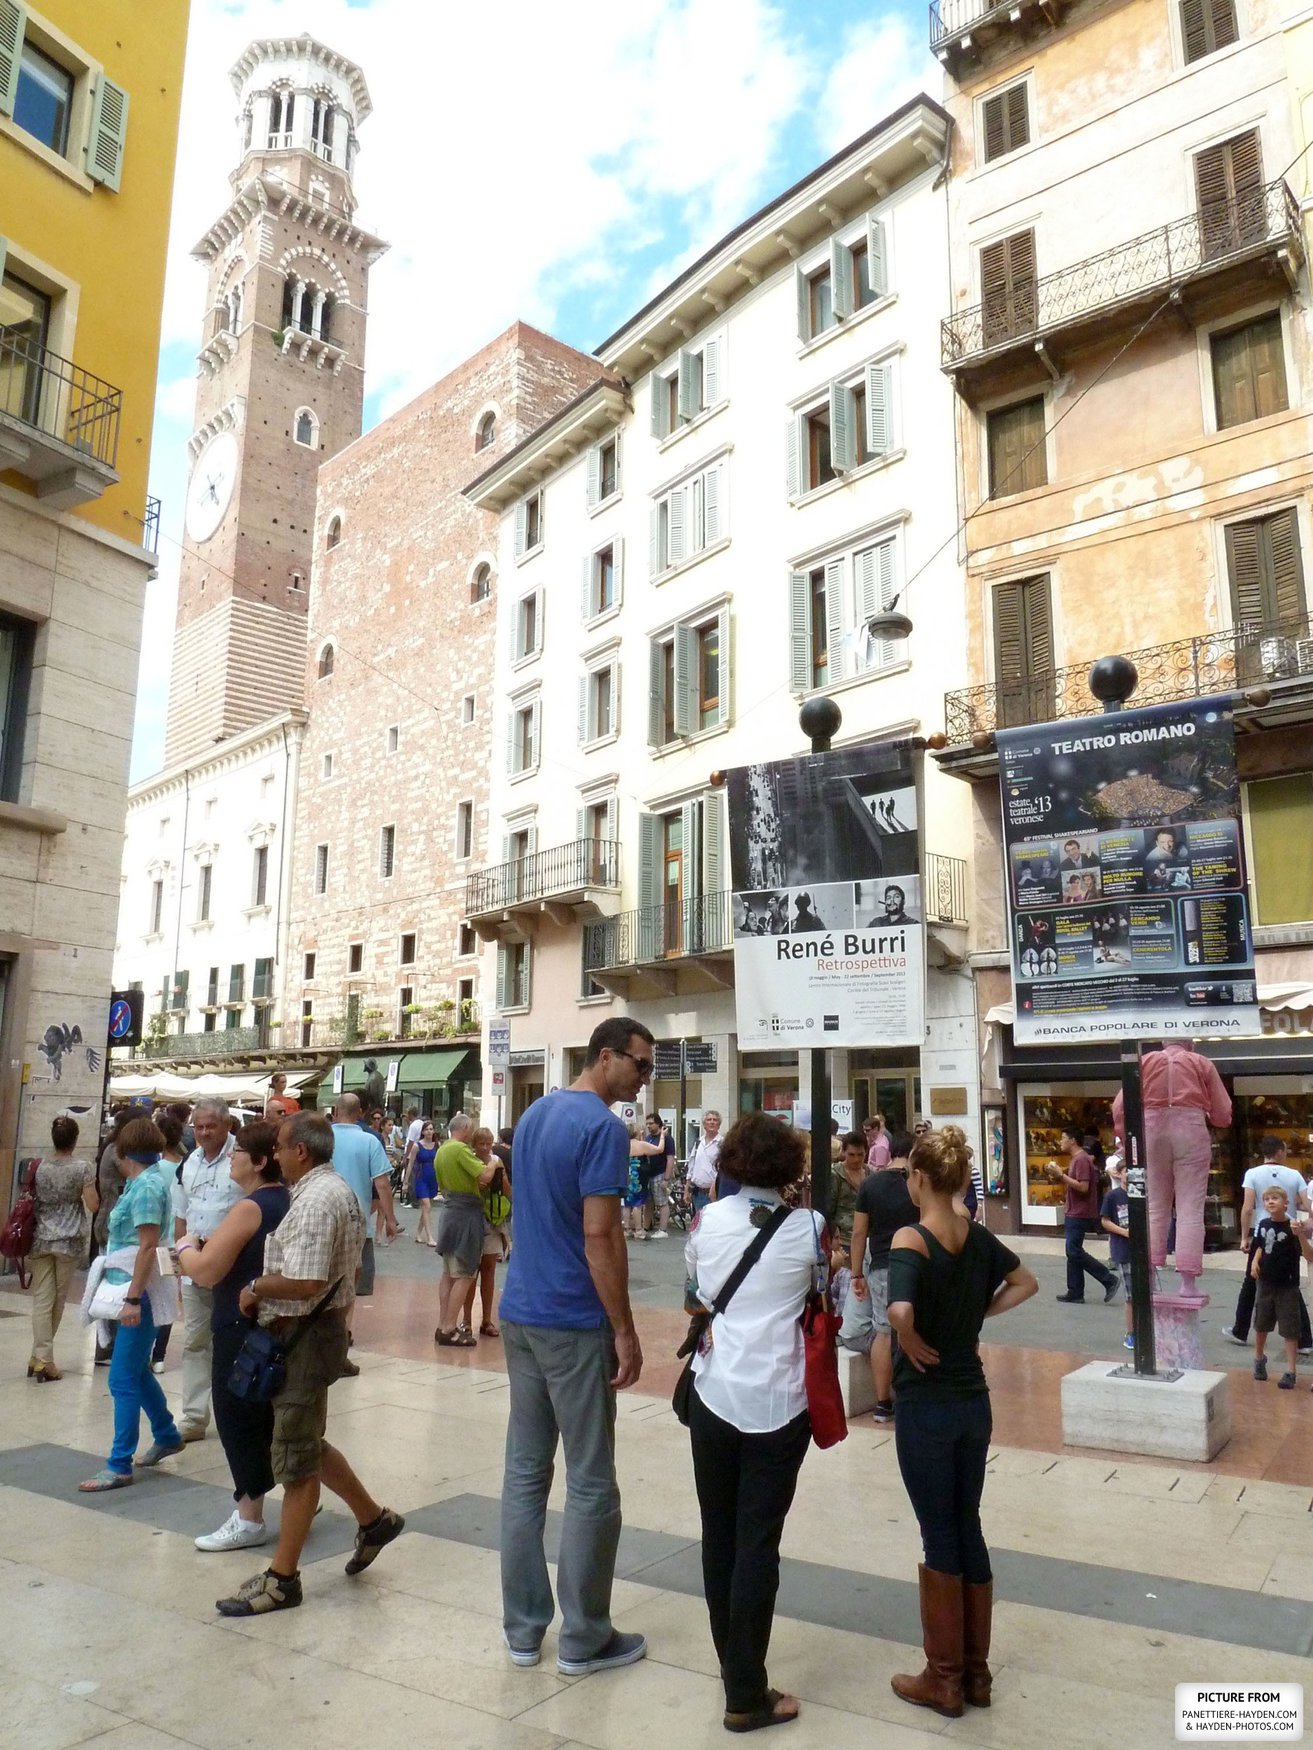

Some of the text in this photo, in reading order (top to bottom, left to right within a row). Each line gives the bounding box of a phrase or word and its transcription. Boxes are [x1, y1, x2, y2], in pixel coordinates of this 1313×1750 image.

[1051, 723, 1196, 756] TEATRO ROMANO
[1009, 797, 1031, 808] estate
[1009, 805, 1038, 817] teatrale
[1010, 814, 1044, 826] veronese
[1032, 833, 1054, 841] FESTIVAL
[777, 929, 906, 960] René Burri
[817, 956, 906, 972] Retrospettiva
[1043, 1026, 1087, 1035] BANCA
[1090, 1022, 1158, 1032] POPOLARE
[1164, 1021, 1178, 1029] DI
[1182, 1019, 1241, 1028] VERONA
[832, 1103, 851, 1115] City
